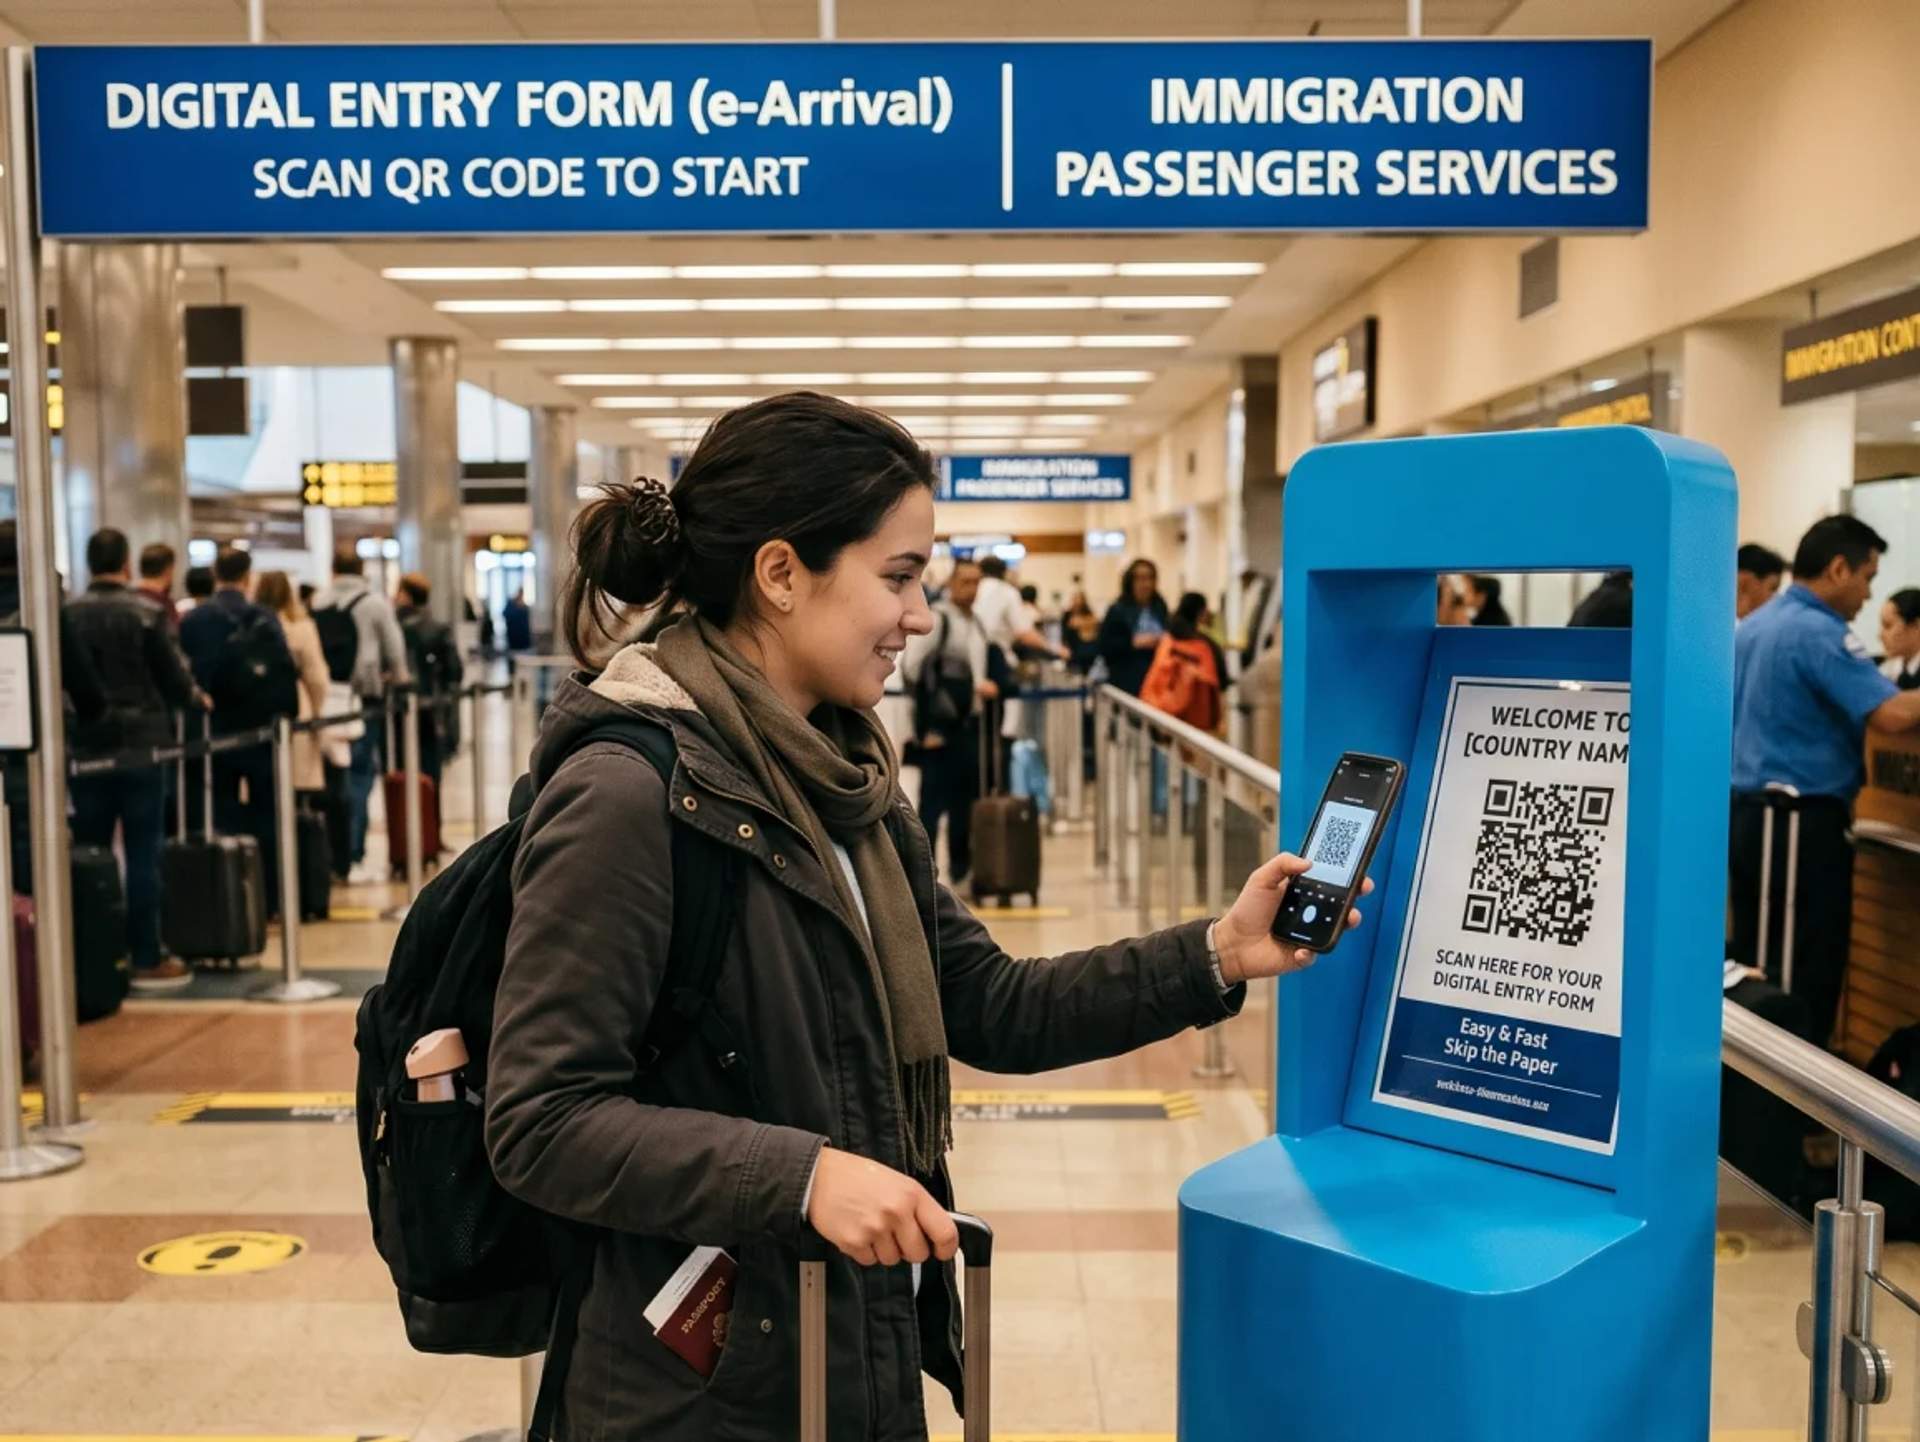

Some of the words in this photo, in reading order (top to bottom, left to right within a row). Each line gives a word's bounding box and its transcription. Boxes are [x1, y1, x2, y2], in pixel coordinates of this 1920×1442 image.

[106, 82, 315, 129] DIGITAL
[329, 81, 502, 128] ENTRY
[517, 80, 673, 128] FORM
[688, 77, 953, 135] (e-Arrival)
[1151, 77, 1523, 124] IMMIGRATION
[253, 158, 372, 199] SCAN
[385, 158, 451, 205] QR
[462, 157, 586, 198] CODE
[596, 157, 660, 198] TO
[672, 156, 809, 197] START
[1056, 150, 1360, 197] PASSENGER
[1375, 149, 1618, 196] SERVICES
[1491, 706, 1597, 731] WELCOME
[1604, 711, 1631, 733] TO
[1463, 732, 1572, 760] [COUNTRY
[1435, 949, 1475, 969] SCAN
[1479, 956, 1518, 976] HERE
[1522, 963, 1553, 982] FOR
[1558, 968, 1603, 990] YOUR
[1433, 971, 1490, 995] DIGITAL
[1494, 982, 1545, 1004] ENTRY
[1548, 991, 1595, 1013] FORM
[1460, 1018, 1494, 1042] Easy
[1499, 1024, 1511, 1042] &
[1514, 1027, 1548, 1050] Fast
[1444, 1037, 1478, 1063] Skip
[1481, 1045, 1506, 1065] the
[1510, 1050, 1558, 1076] Paper
